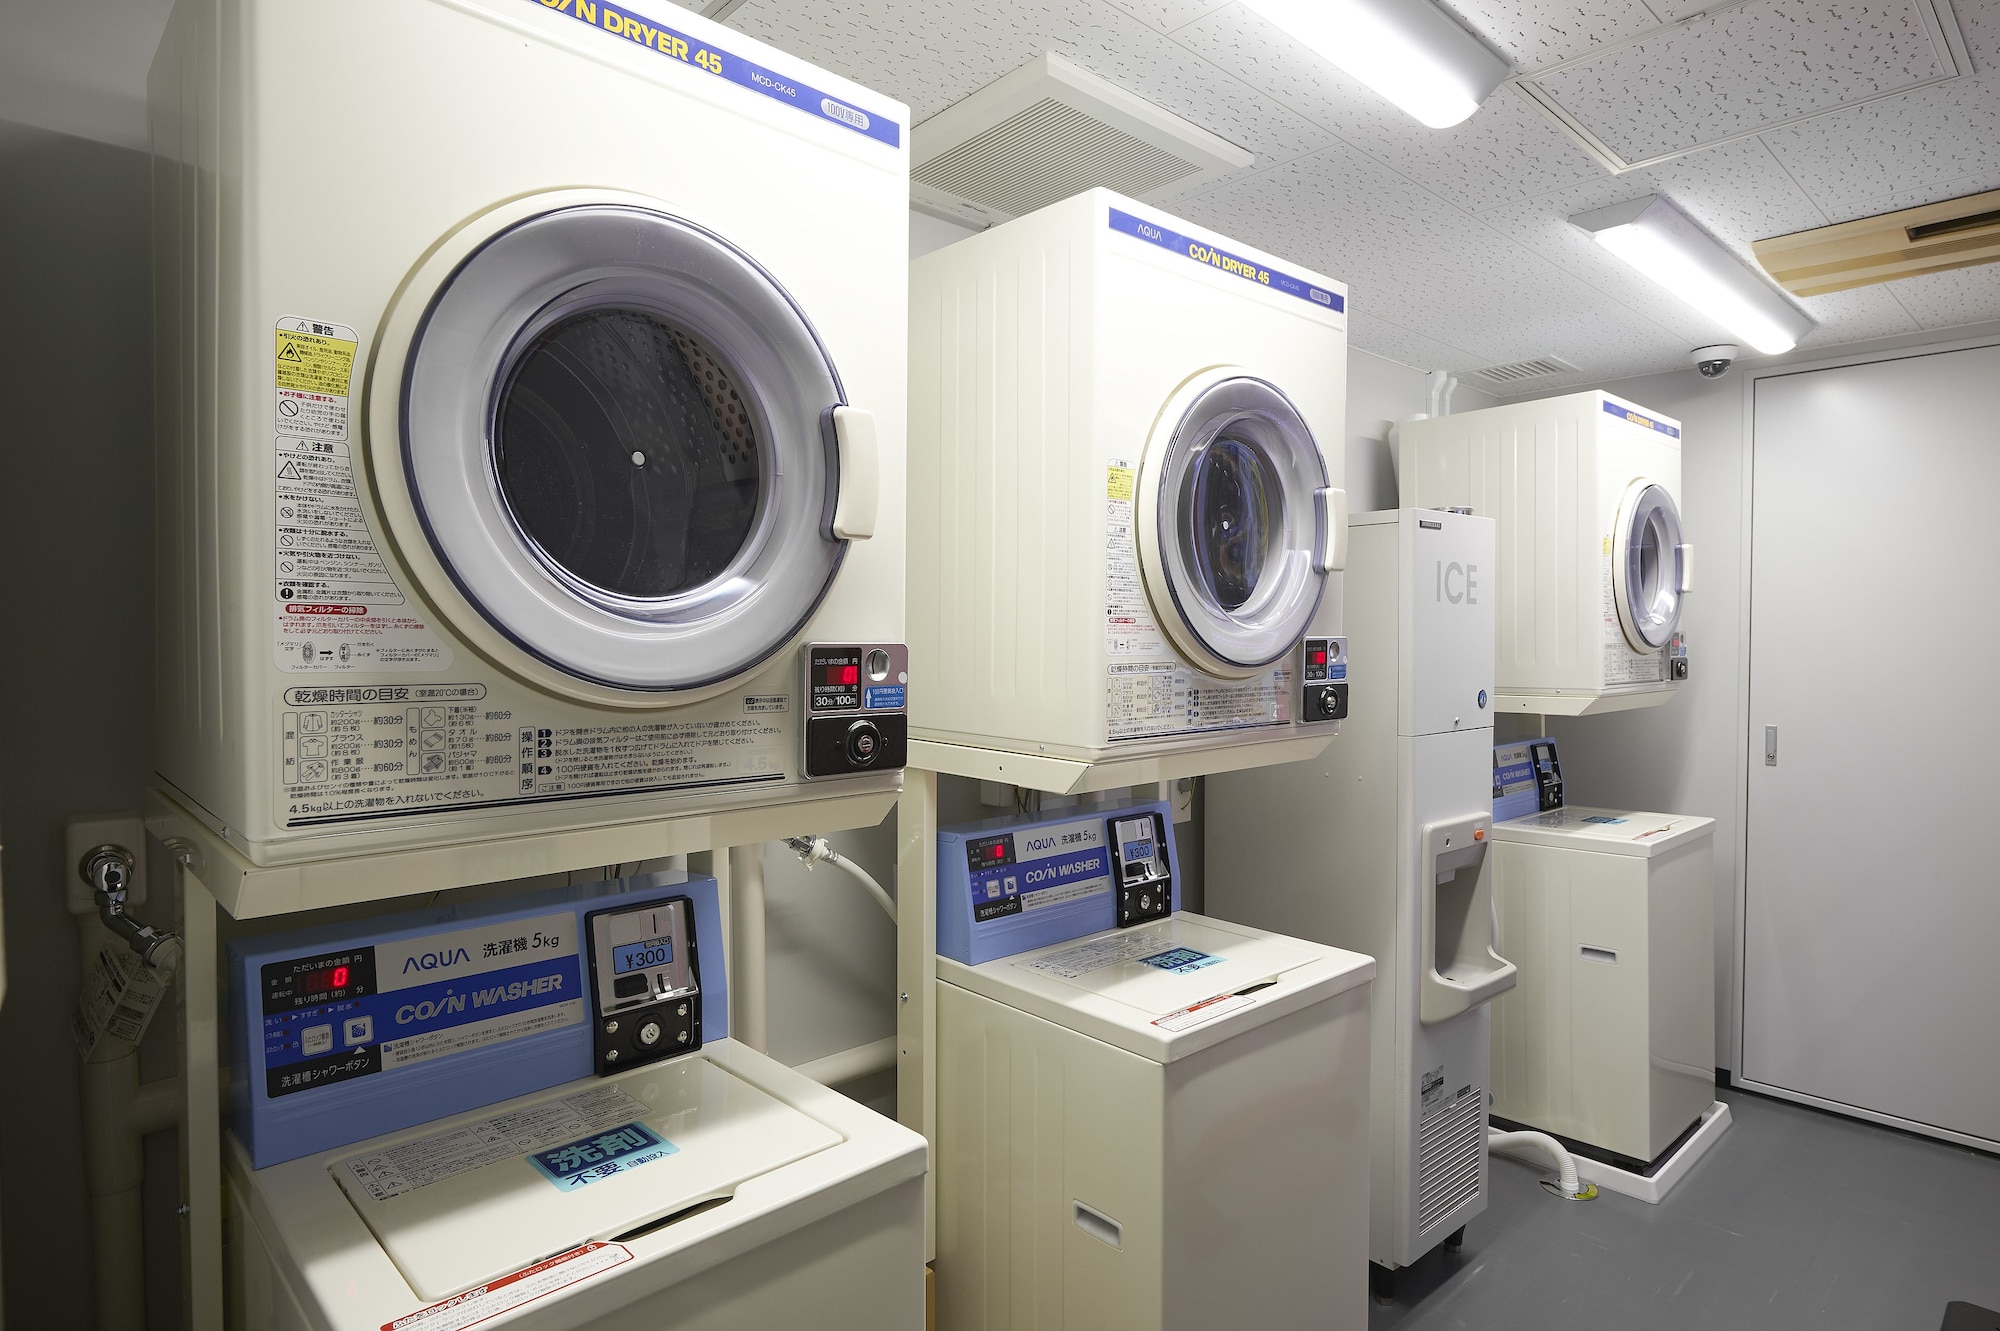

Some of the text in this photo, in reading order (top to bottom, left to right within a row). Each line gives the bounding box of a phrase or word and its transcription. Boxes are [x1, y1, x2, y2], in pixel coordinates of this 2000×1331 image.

[603, 8, 723, 75] DRYER 45
[751, 71, 797, 99] MCD-CK45
[826, 101, 865, 127] 100V専用
[1137, 223, 1163, 242] AQUA
[1222, 256, 1256, 281] DRYER
[1257, 270, 1270, 285] 45
[312, 323, 335, 336] 警告
[312, 442, 334, 453] 注意
[283, 495, 324, 503] 水をかけない。
[283, 528, 348, 537] 衣類は十分に脱水する。
[283, 551, 360, 560] 火気や引火物を近づけない。
[1436, 560, 1478, 605] ICE
[294, 687, 410, 703] 乾燥時間の目安
[373, 715, 404, 726] 約30分
[330, 734, 364, 742] ブラウス
[373, 738, 404, 748] 約30分
[408, 725, 417, 759] もめん
[373, 762, 404, 772] 約60分
[521, 731, 534, 790] 操作順序
[289, 789, 485, 814] 4.5kg以上の洗濯物を入れないでください。
[1026, 837, 1057, 853] AQUA
[1083, 830, 1098, 843] 5kg
[995, 844, 1004, 858] 0
[1129, 845, 1150, 858] ¥300
[1058, 857, 1100, 876] WASHER
[482, 932, 560, 959] 洗濯機 5kg
[293, 954, 363, 973] ただいまの金額 円
[402, 948, 470, 974] AQUA
[625, 948, 665, 969] ¥300
[332, 966, 348, 987] 0
[356, 985, 365, 994] 分
[471, 973, 563, 1008] WASHER
[281, 1058, 370, 1088] 洗濯槽シャワーボタン
[546, 1127, 649, 1173] 洗剤
[565, 1161, 624, 1185] 不要
[392, 1286, 488, 1330] ふたをロックします
